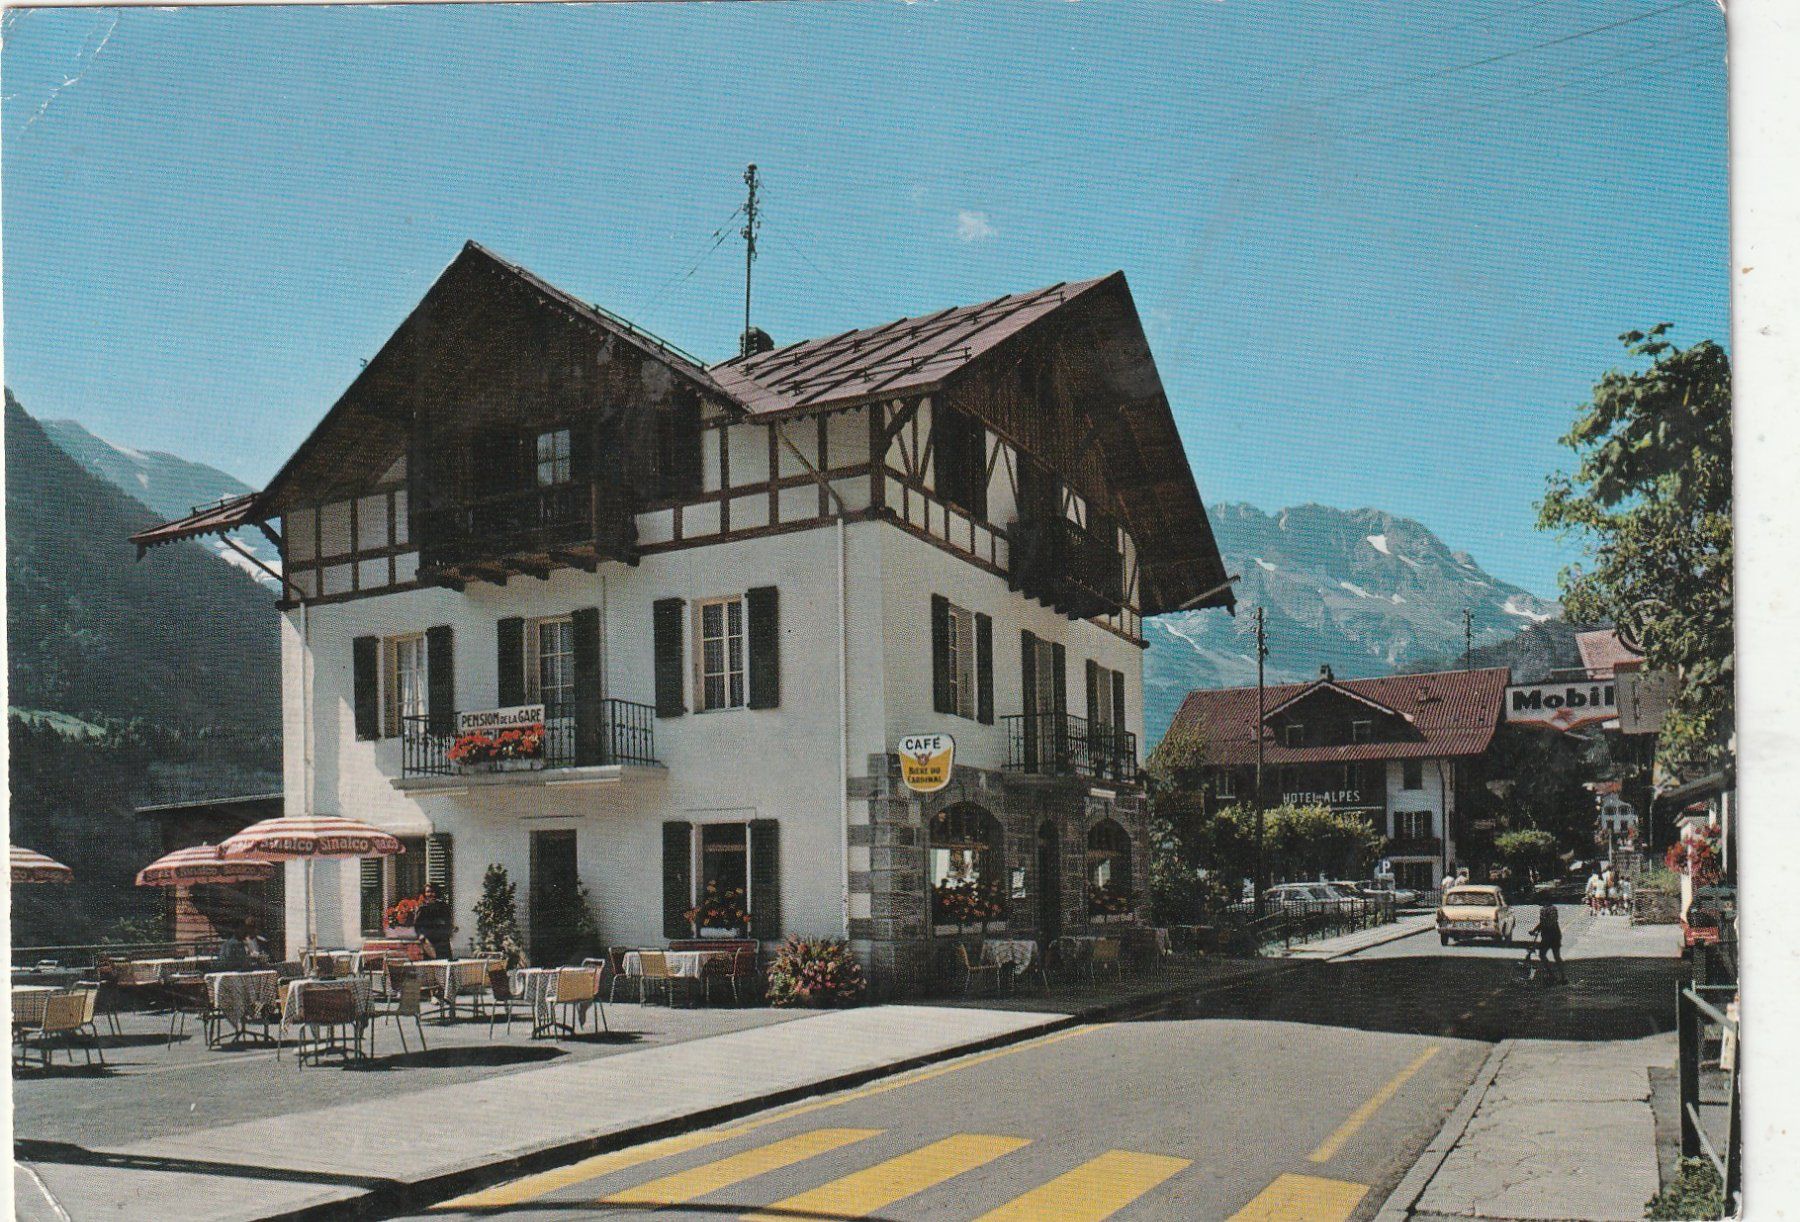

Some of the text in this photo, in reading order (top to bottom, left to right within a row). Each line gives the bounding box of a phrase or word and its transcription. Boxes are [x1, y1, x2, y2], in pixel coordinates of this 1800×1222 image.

[1512, 686, 1614, 711] Mobil
[461, 712, 499, 728] PENSION
[518, 708, 542, 722] GARE
[905, 736, 941, 750] CAFÉ
[1283, 791, 1316, 804] HOTEL
[1324, 790, 1361, 802] ALPES
[320, 836, 370, 851] Sinalco
[1382, 860, 1391, 874] P
